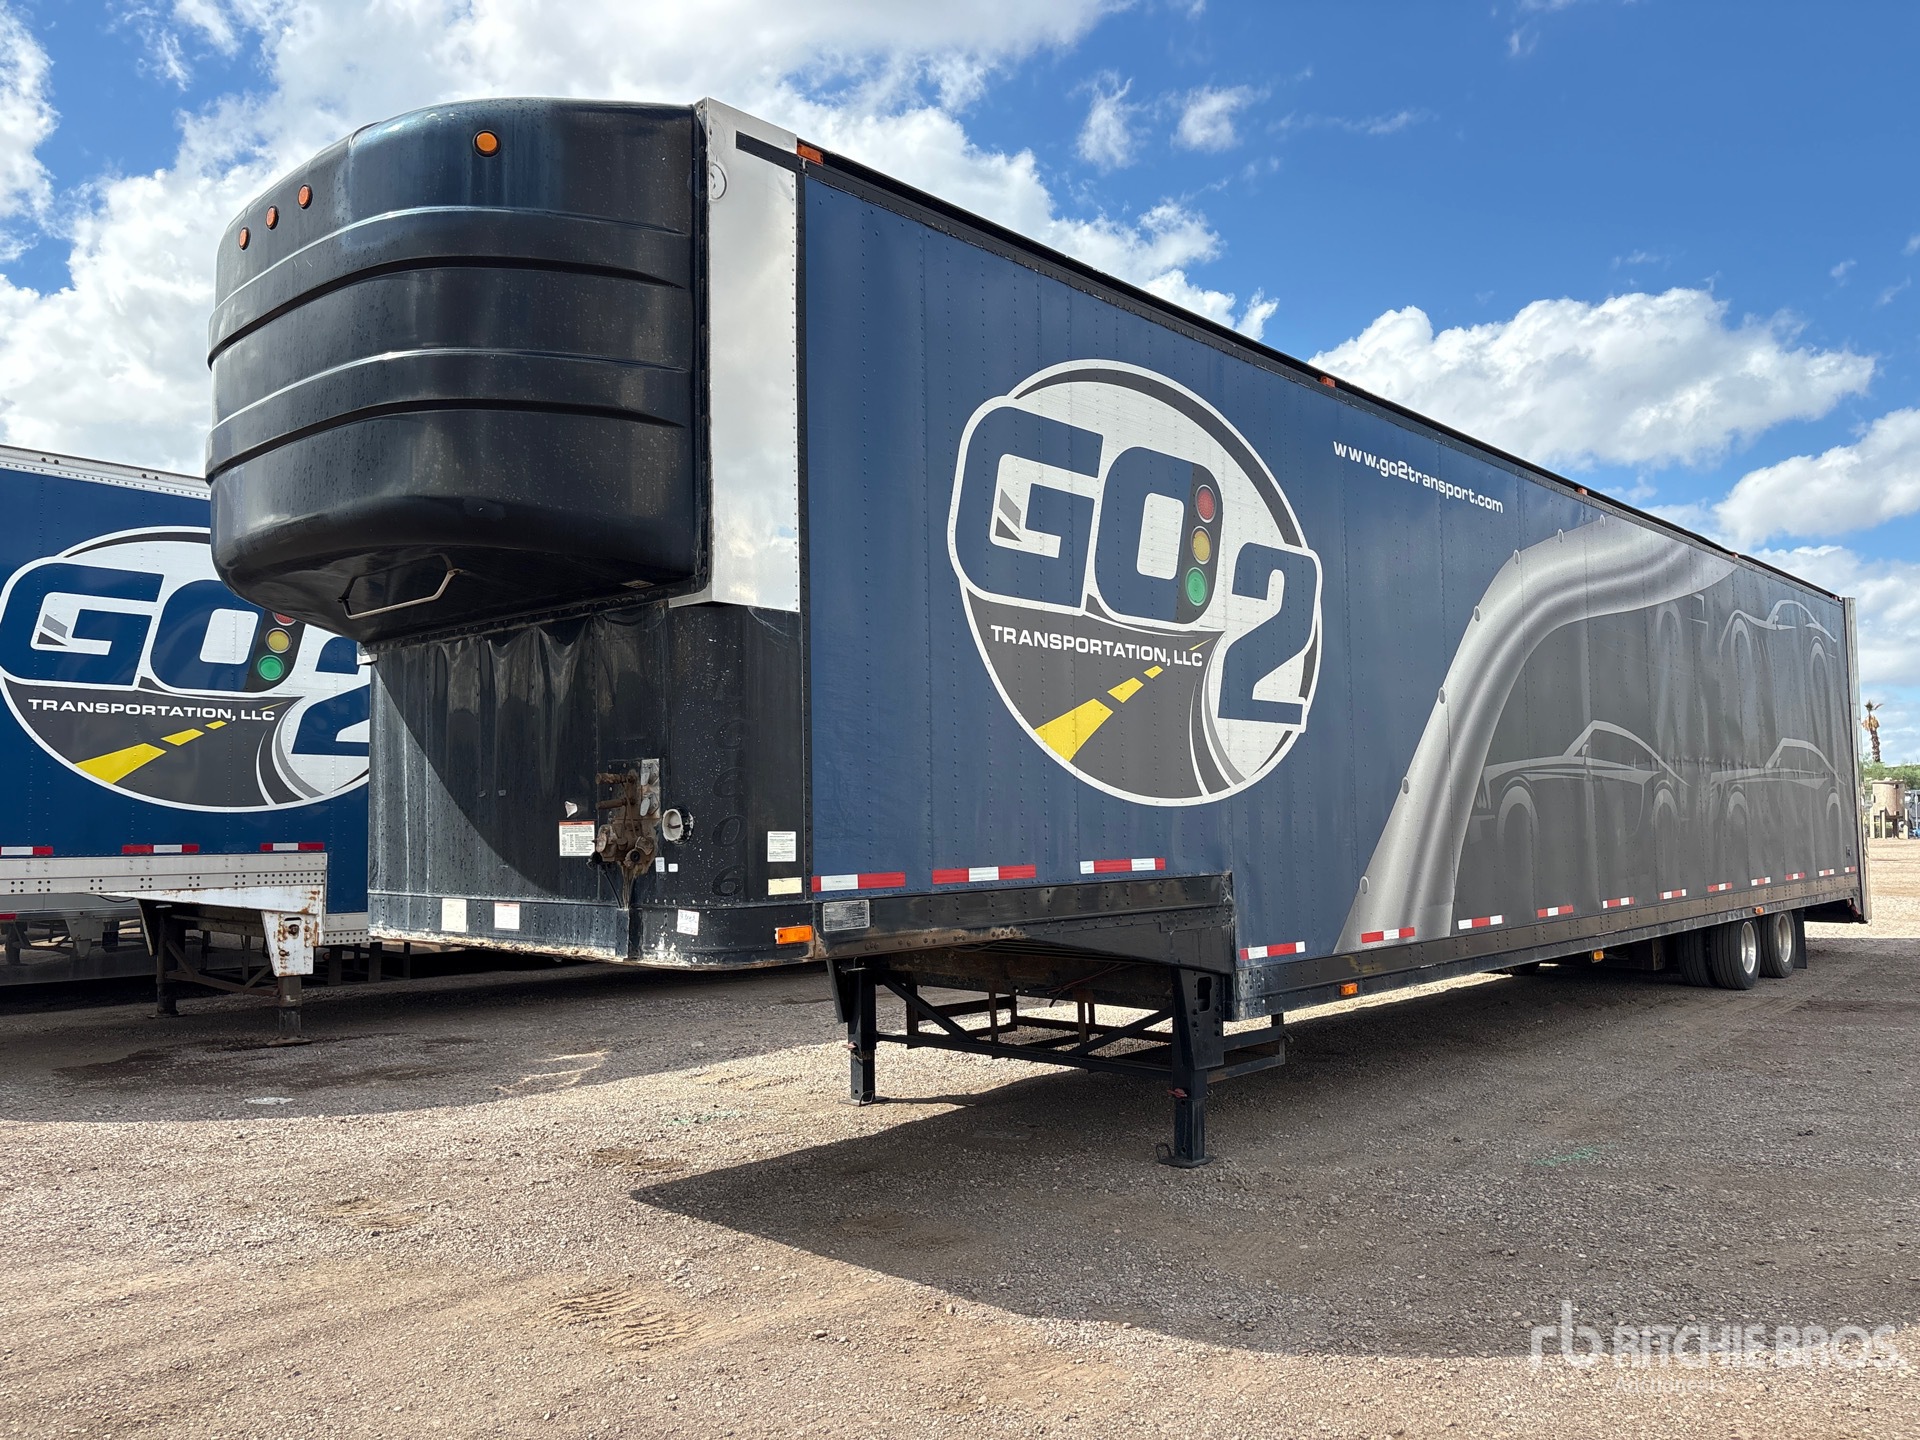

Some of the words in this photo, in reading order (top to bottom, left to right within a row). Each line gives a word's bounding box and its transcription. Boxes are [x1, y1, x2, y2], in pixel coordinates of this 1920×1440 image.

[1332, 440, 1504, 514] www.go2transport.com
[990, 624, 1171, 667] TRANSPORTATION,
[1173, 650, 1203, 667] LLC
[28, 698, 236, 722] TRANSPORTATION,
[240, 709, 276, 722] LLC
